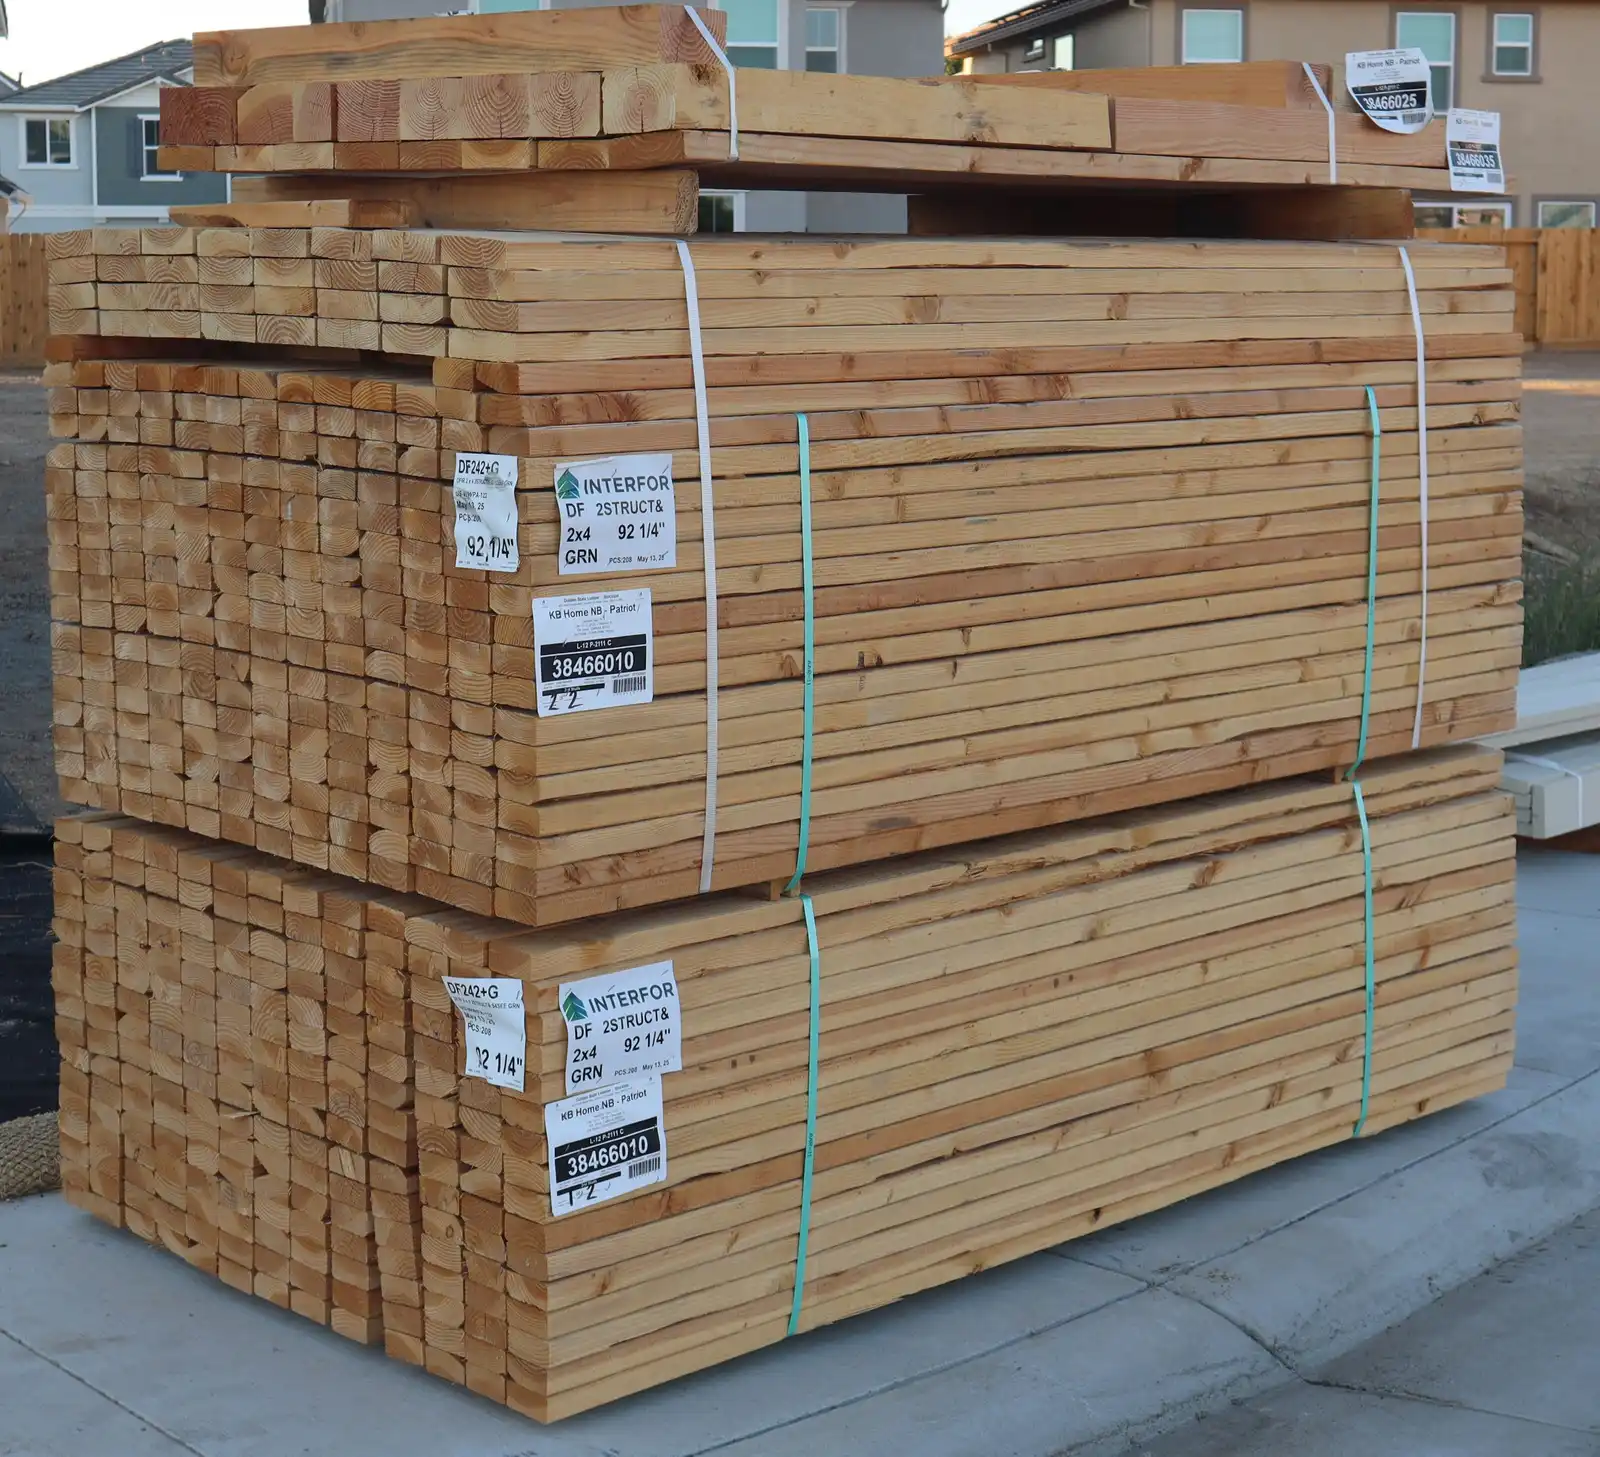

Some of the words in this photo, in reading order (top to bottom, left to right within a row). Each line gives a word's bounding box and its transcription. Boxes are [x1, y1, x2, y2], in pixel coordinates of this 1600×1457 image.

[1363, 94, 1417, 110] 38466025
[1456, 152, 1496, 168] 38466035
[458, 460, 500, 474] DF242+G
[584, 475, 670, 494] INTERFOR
[566, 502, 584, 518] DF
[596, 499, 664, 516] 2STRUCT&
[566, 526, 590, 542] 2x4
[618, 524, 634, 540] 92
[640, 522, 665, 538] 1/4"
[565, 548, 598, 564] GRN
[549, 610, 562, 619] KB
[564, 609, 588, 618] Home
[591, 606, 603, 616] NB
[610, 604, 636, 614] Patriot
[590, 640, 606, 648] P-2111
[552, 651, 634, 679] 38466010
[447, 982, 498, 999] DF242+G
[589, 982, 674, 1013] INTERFOR
[574, 1023, 592, 1040] DF
[603, 1007, 669, 1034] 2STRUCT&
[572, 1045, 597, 1063] 2x4
[624, 1036, 640, 1052] 92
[645, 1028, 671, 1047] 1/4"
[495, 1052, 522, 1076] 1/4"
[571, 1064, 603, 1084] GRN
[561, 1111, 574, 1121] KB
[576, 1106, 600, 1117] Home
[602, 1099, 614, 1109] NB
[622, 1090, 647, 1104] Patriot
[590, 1135, 602, 1144] L-12
[602, 1130, 619, 1141] P-2111
[568, 1135, 648, 1177] 38466010
